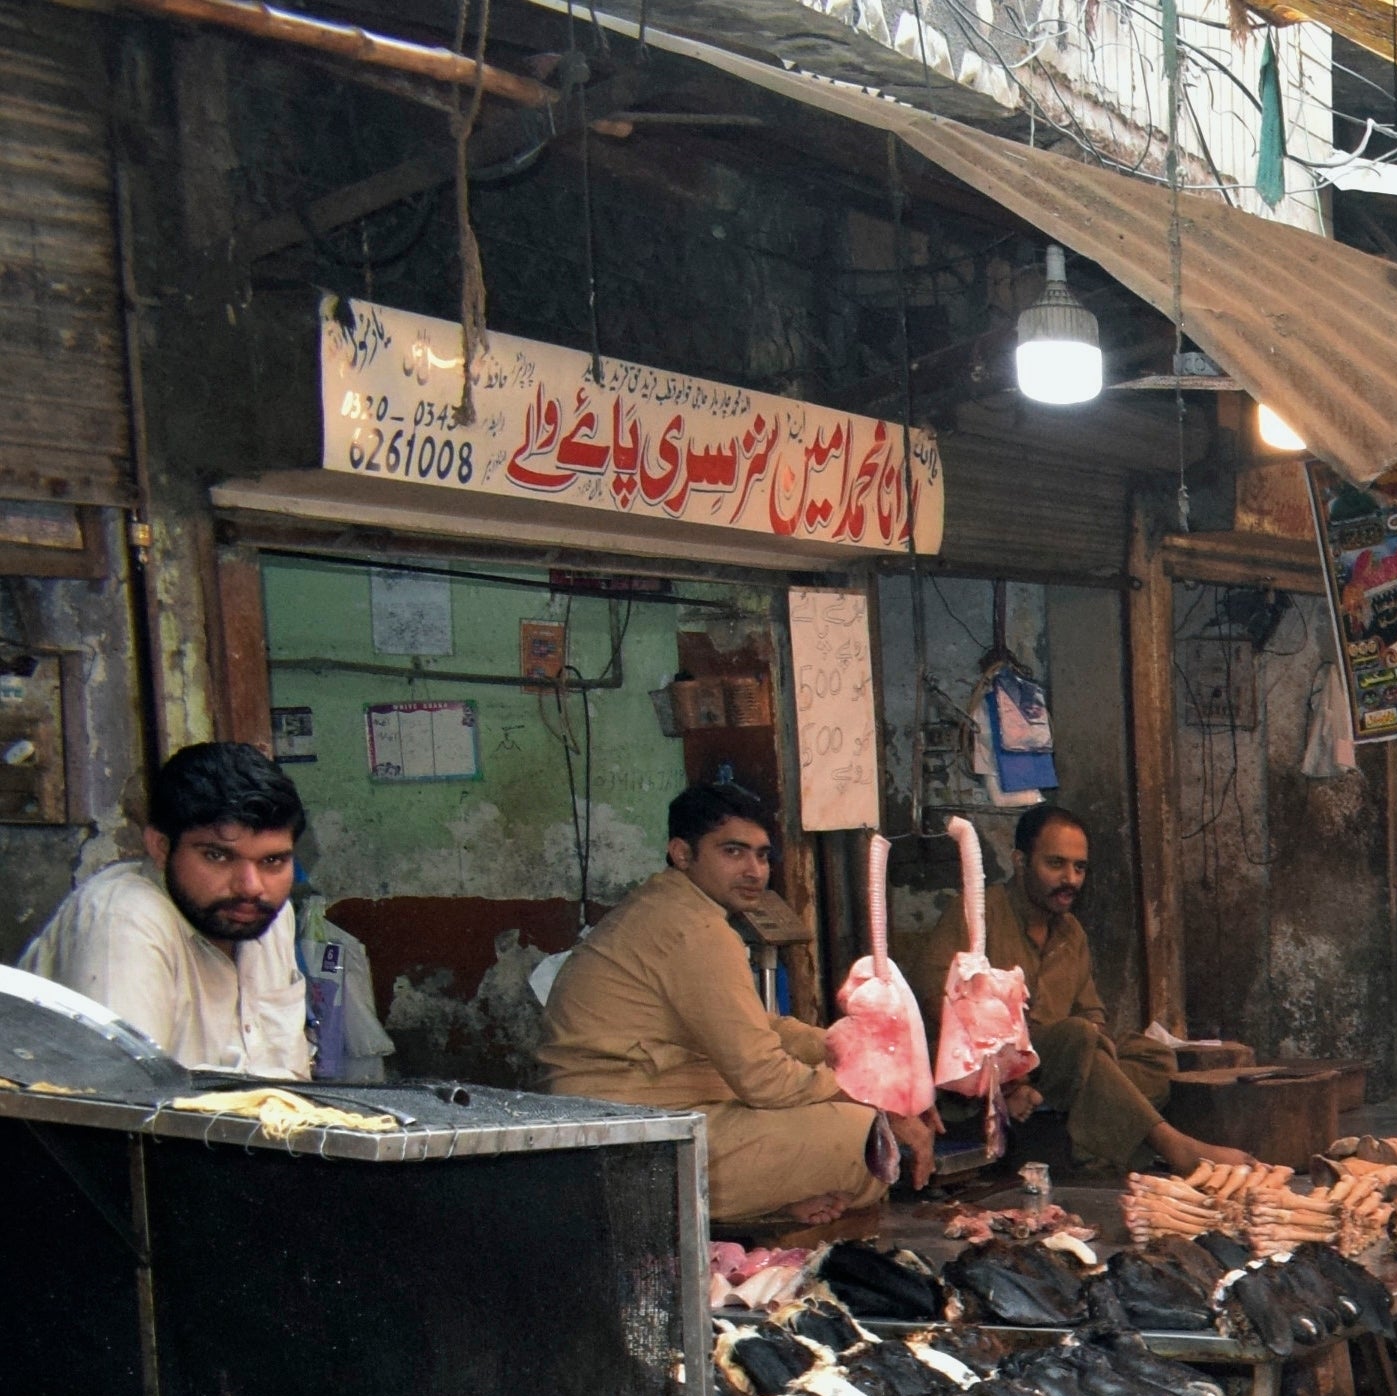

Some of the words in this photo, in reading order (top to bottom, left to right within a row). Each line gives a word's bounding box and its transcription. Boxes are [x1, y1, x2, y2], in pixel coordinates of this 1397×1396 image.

[609, 363, 628, 392] فرید
[641, 371, 657, 399] فرید
[656, 377, 676, 405] قطب
[349, 427, 473, 484] 6261008
[504, 380, 580, 494] والے
[556, 386, 642, 512] پائے
[640, 412, 738, 518] سری
[730, 412, 782, 522] سنز
[768, 418, 854, 540] امین
[832, 420, 884, 543] محمد
